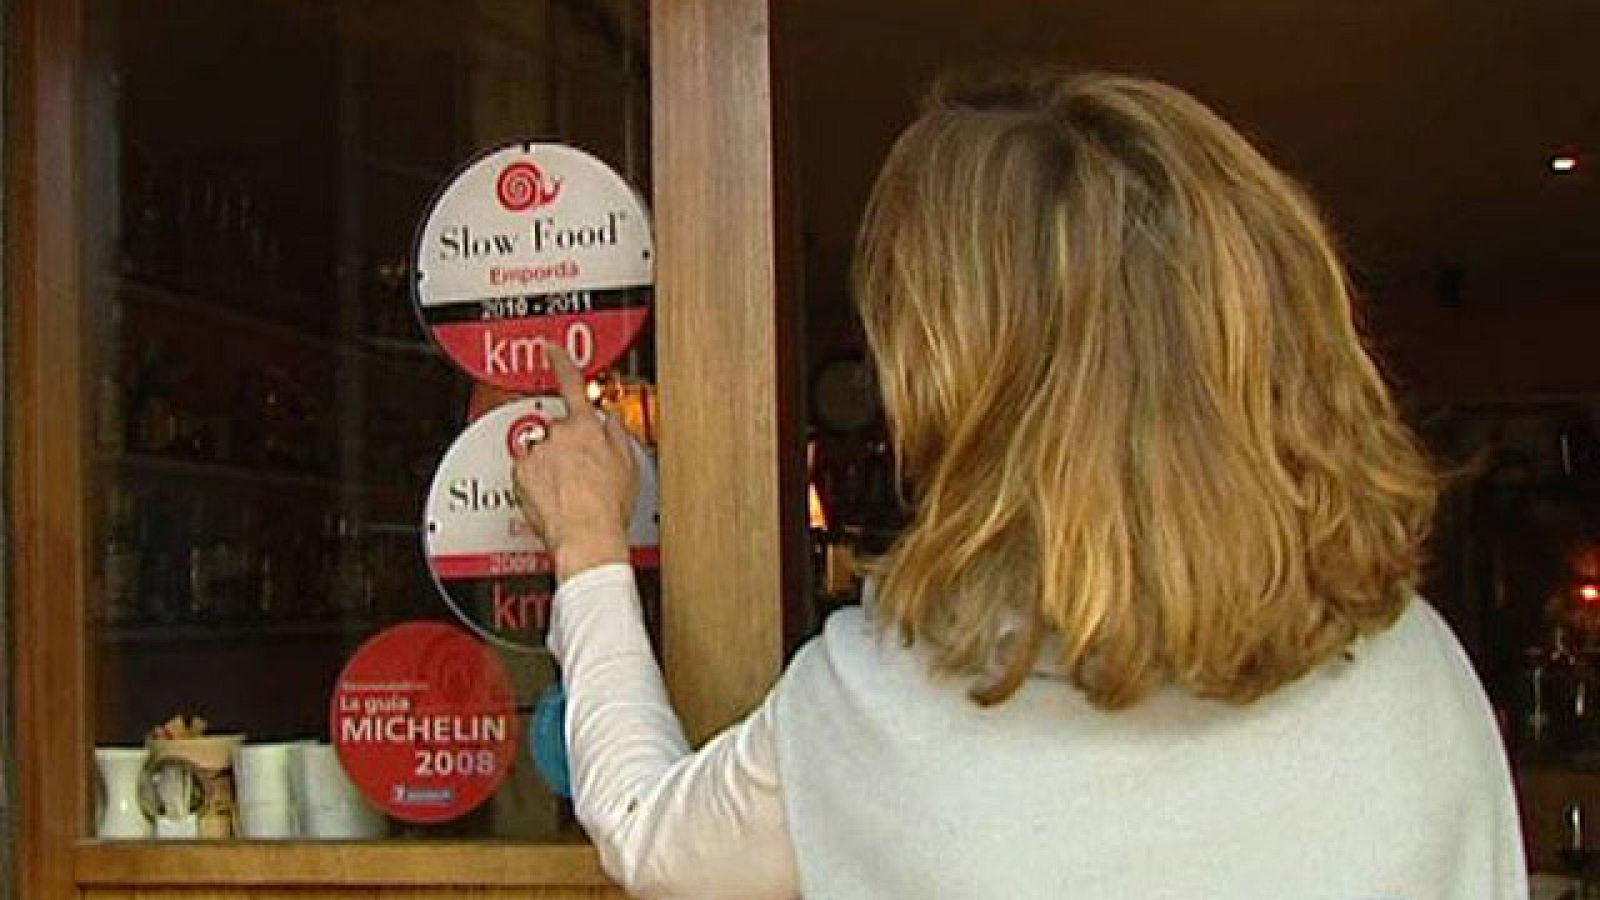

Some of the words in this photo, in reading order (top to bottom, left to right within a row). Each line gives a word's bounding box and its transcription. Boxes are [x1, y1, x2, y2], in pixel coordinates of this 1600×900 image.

[440, 226, 516, 259] Slow
[534, 212, 616, 252] Food
[484, 330, 551, 374] km
[567, 323, 594, 368] 0
[340, 696, 361, 711] La
[341, 715, 507, 742] MICHELIN
[415, 750, 495, 777] 2008
